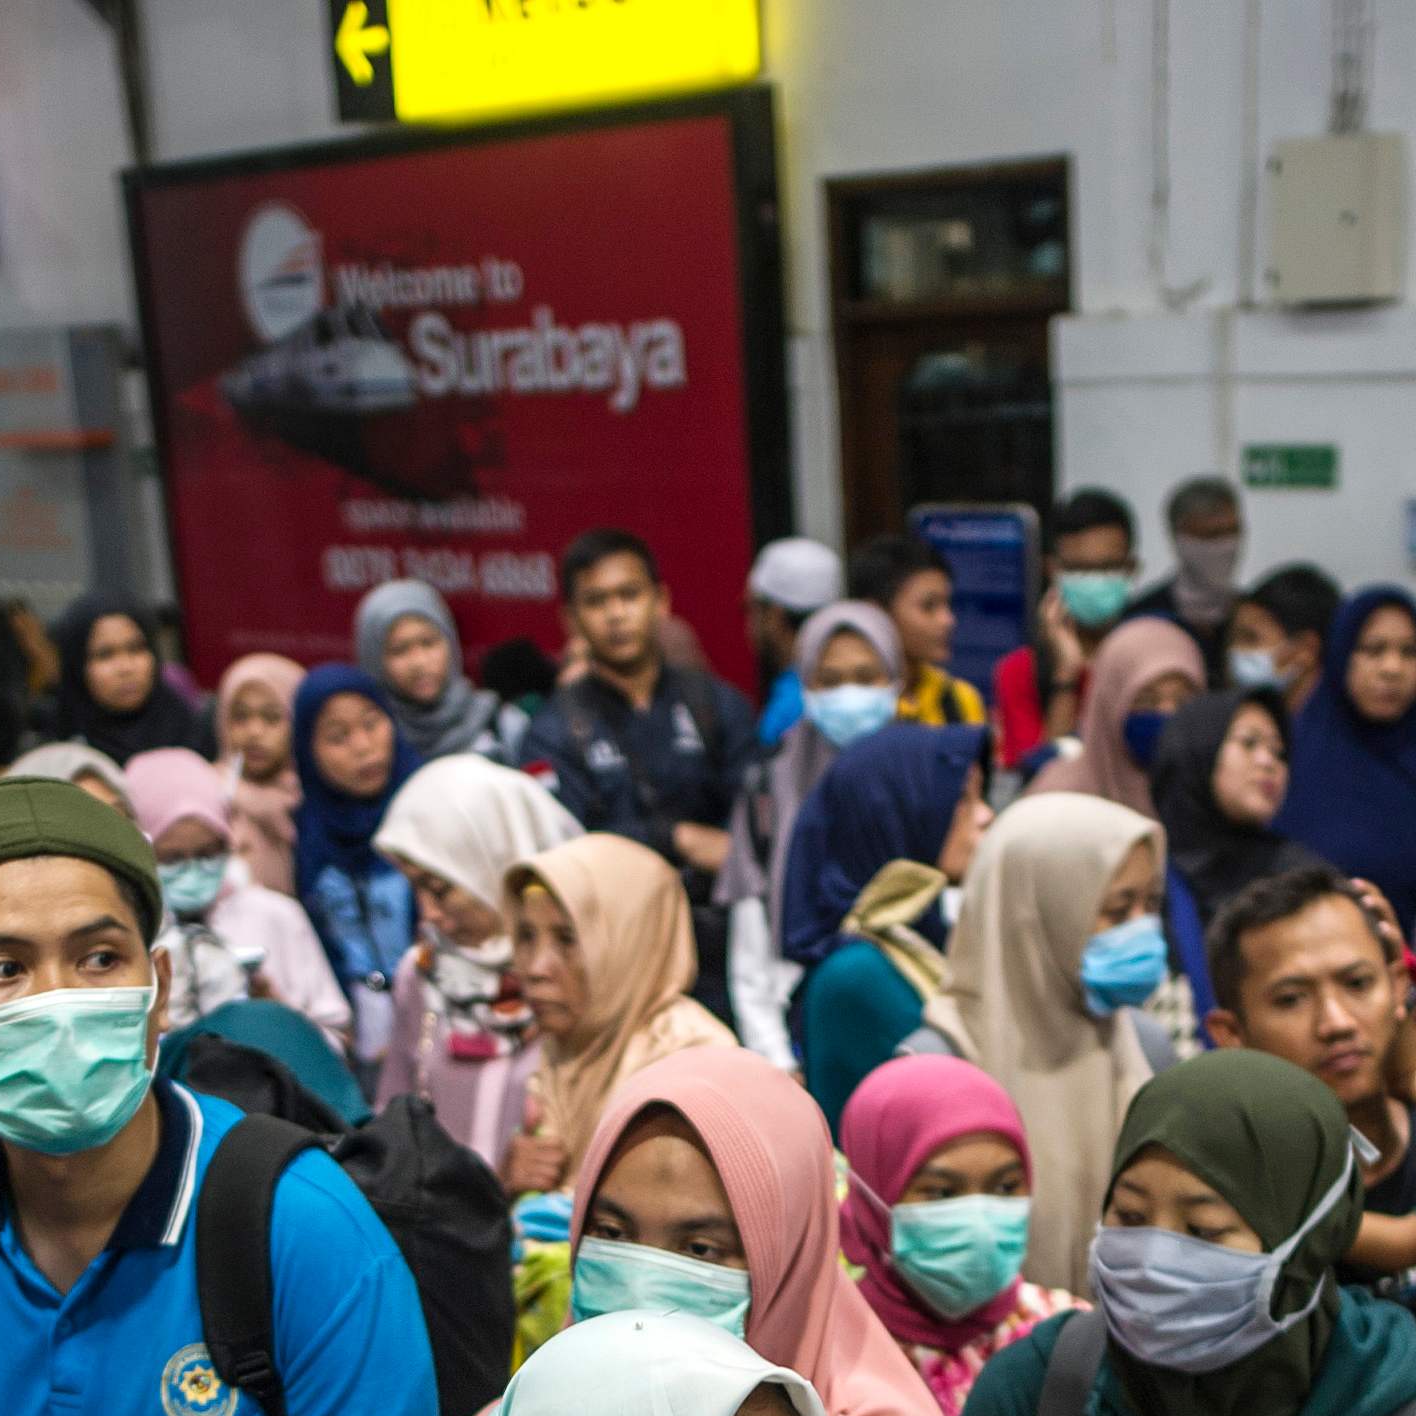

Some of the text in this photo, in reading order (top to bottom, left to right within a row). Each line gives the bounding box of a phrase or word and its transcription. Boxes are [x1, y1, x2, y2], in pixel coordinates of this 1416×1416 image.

[335, 257, 524, 305] Welcome to
[409, 304, 686, 412] Surabaya
